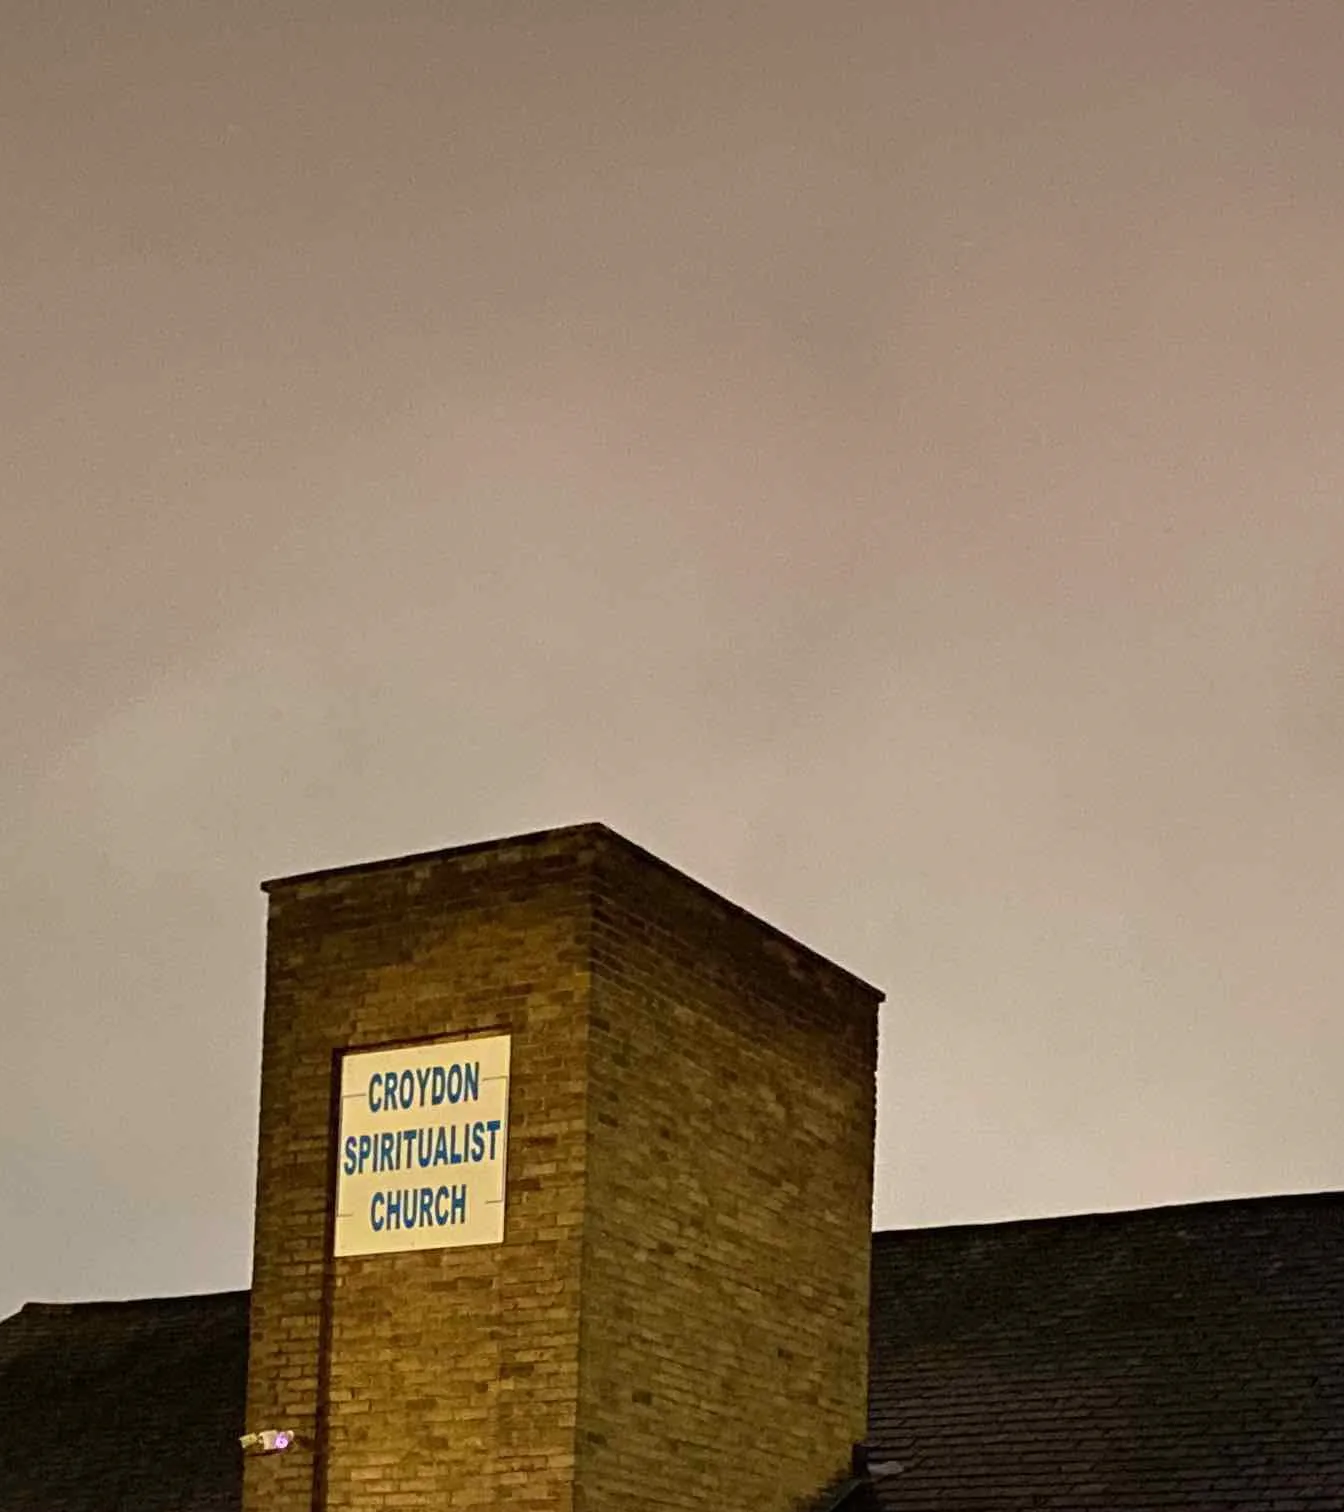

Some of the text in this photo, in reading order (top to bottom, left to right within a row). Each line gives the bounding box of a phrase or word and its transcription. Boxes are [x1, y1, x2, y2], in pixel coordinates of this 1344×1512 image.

[368, 1061, 480, 1113] CROYDON
[343, 1119, 501, 1176] SPIRITUALIST
[370, 1184, 467, 1232] CHURCH
